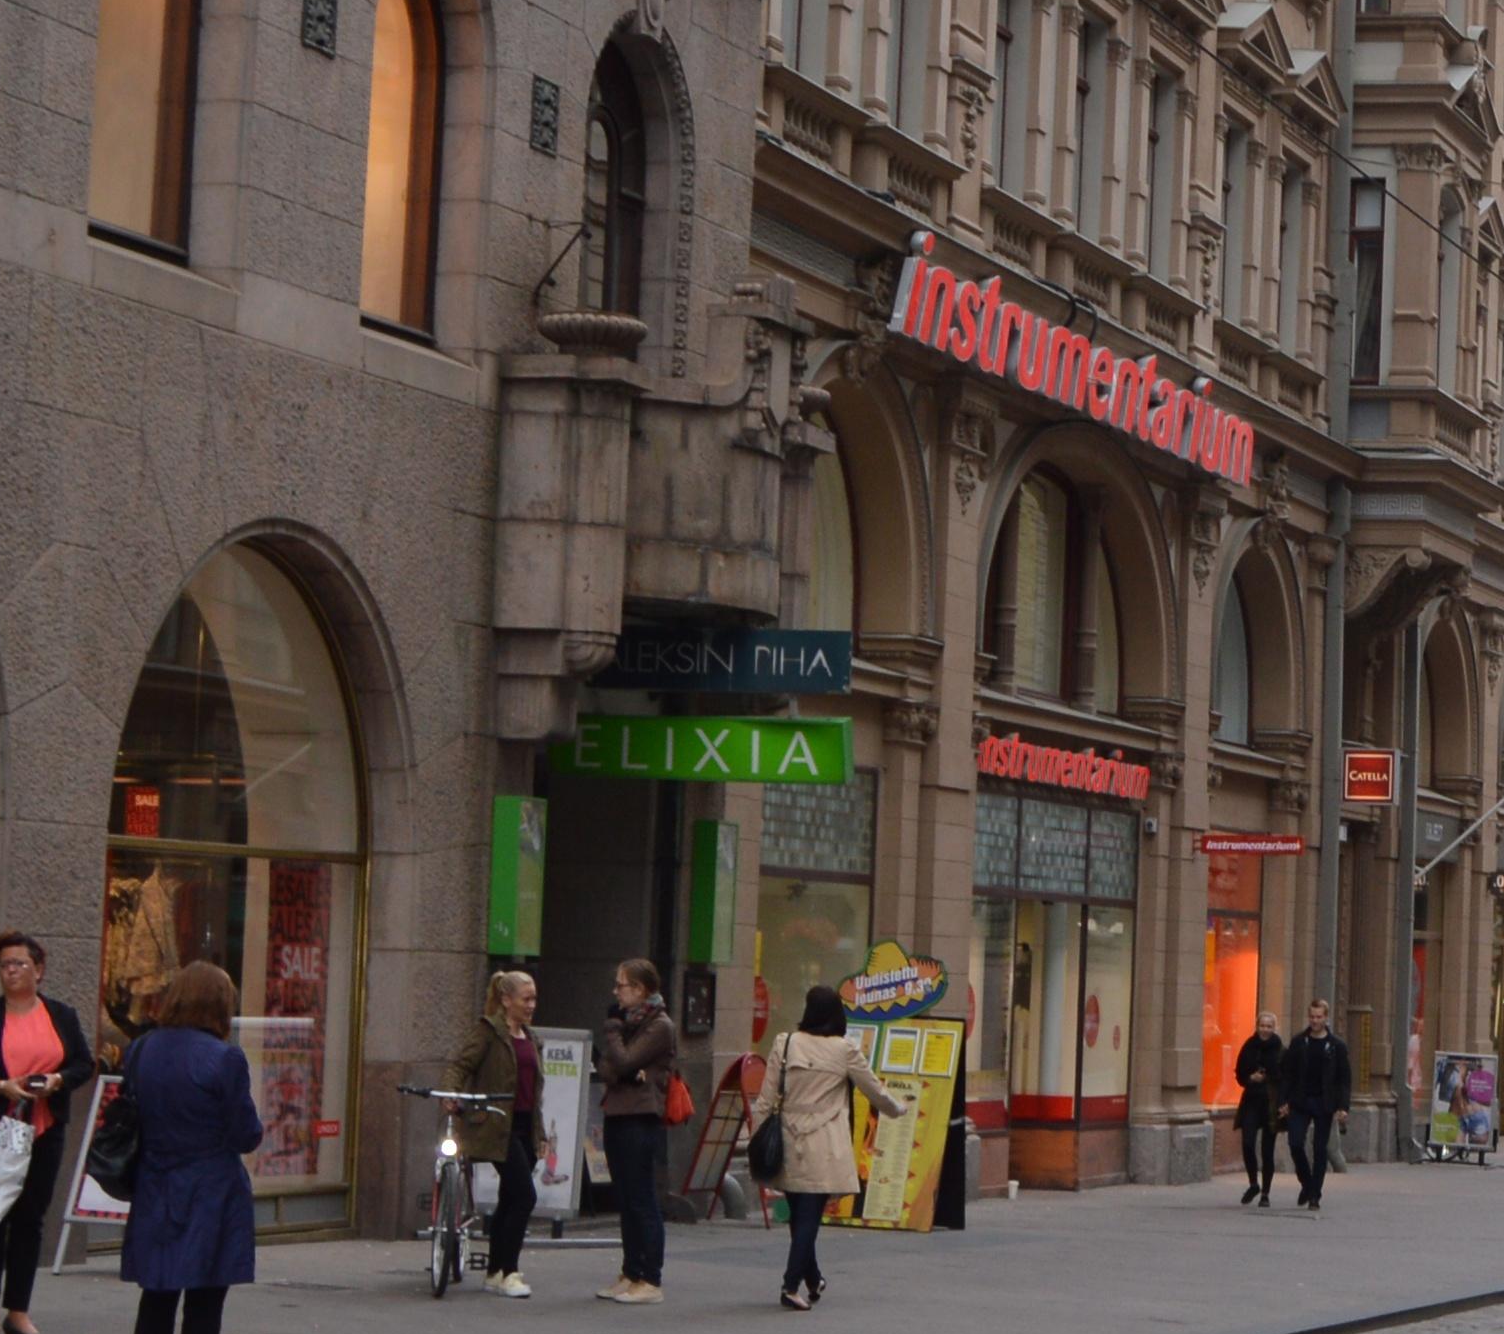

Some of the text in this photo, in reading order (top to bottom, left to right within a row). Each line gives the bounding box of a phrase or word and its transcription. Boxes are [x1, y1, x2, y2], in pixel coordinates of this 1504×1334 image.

[894, 231, 1254, 487] instrumentarium
[575, 723, 819, 776] ELIXIA
[280, 945, 322, 980] SALE
